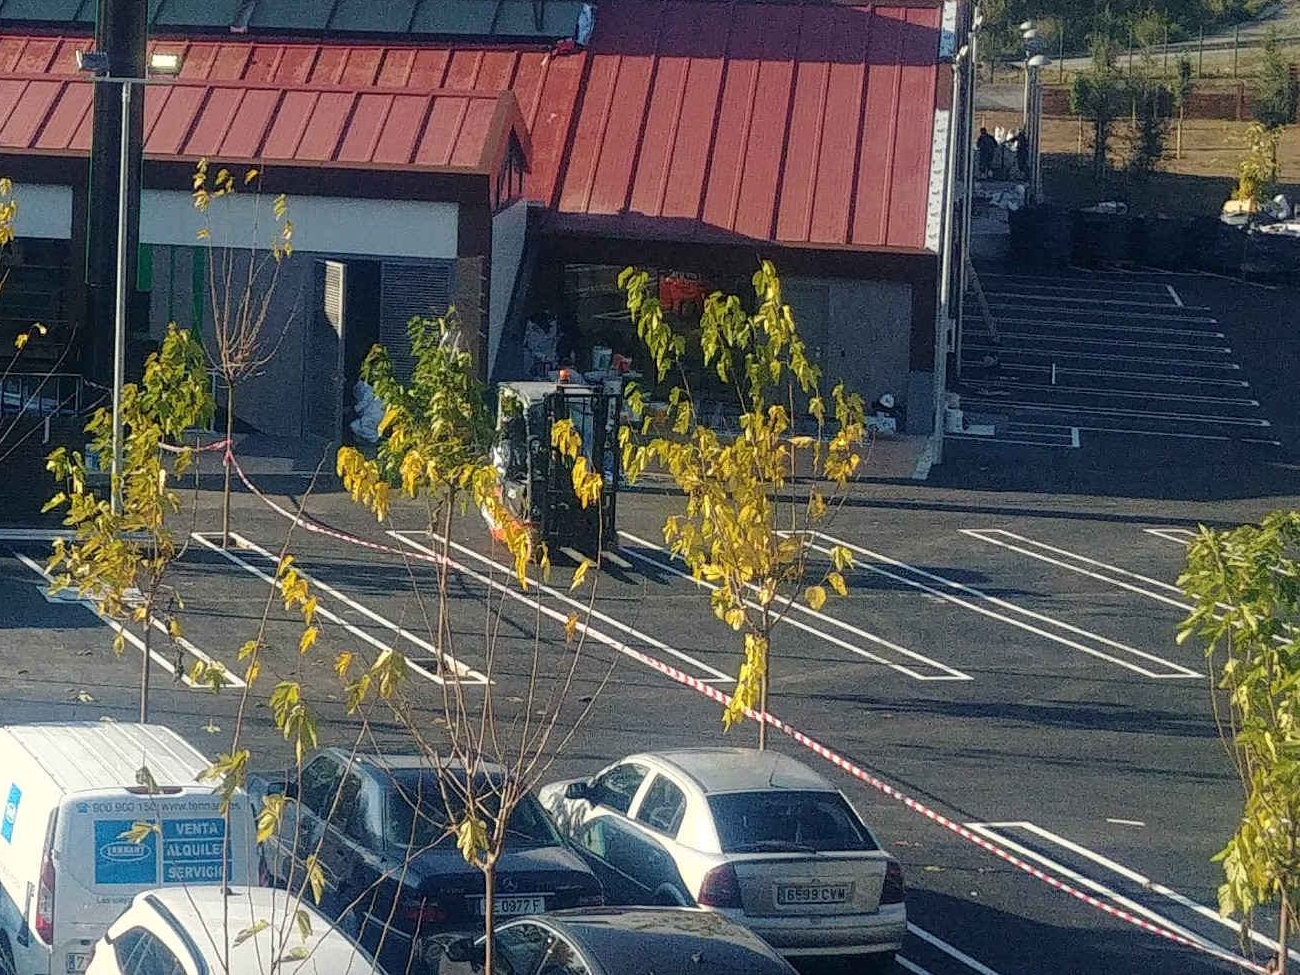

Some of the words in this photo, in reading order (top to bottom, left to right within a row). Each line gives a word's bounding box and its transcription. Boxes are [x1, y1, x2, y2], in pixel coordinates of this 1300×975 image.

[92, 802, 113, 813] 900
[115, 802, 135, 813] 900
[175, 822, 219, 835] VENTA
[533, 899, 541, 912] F
